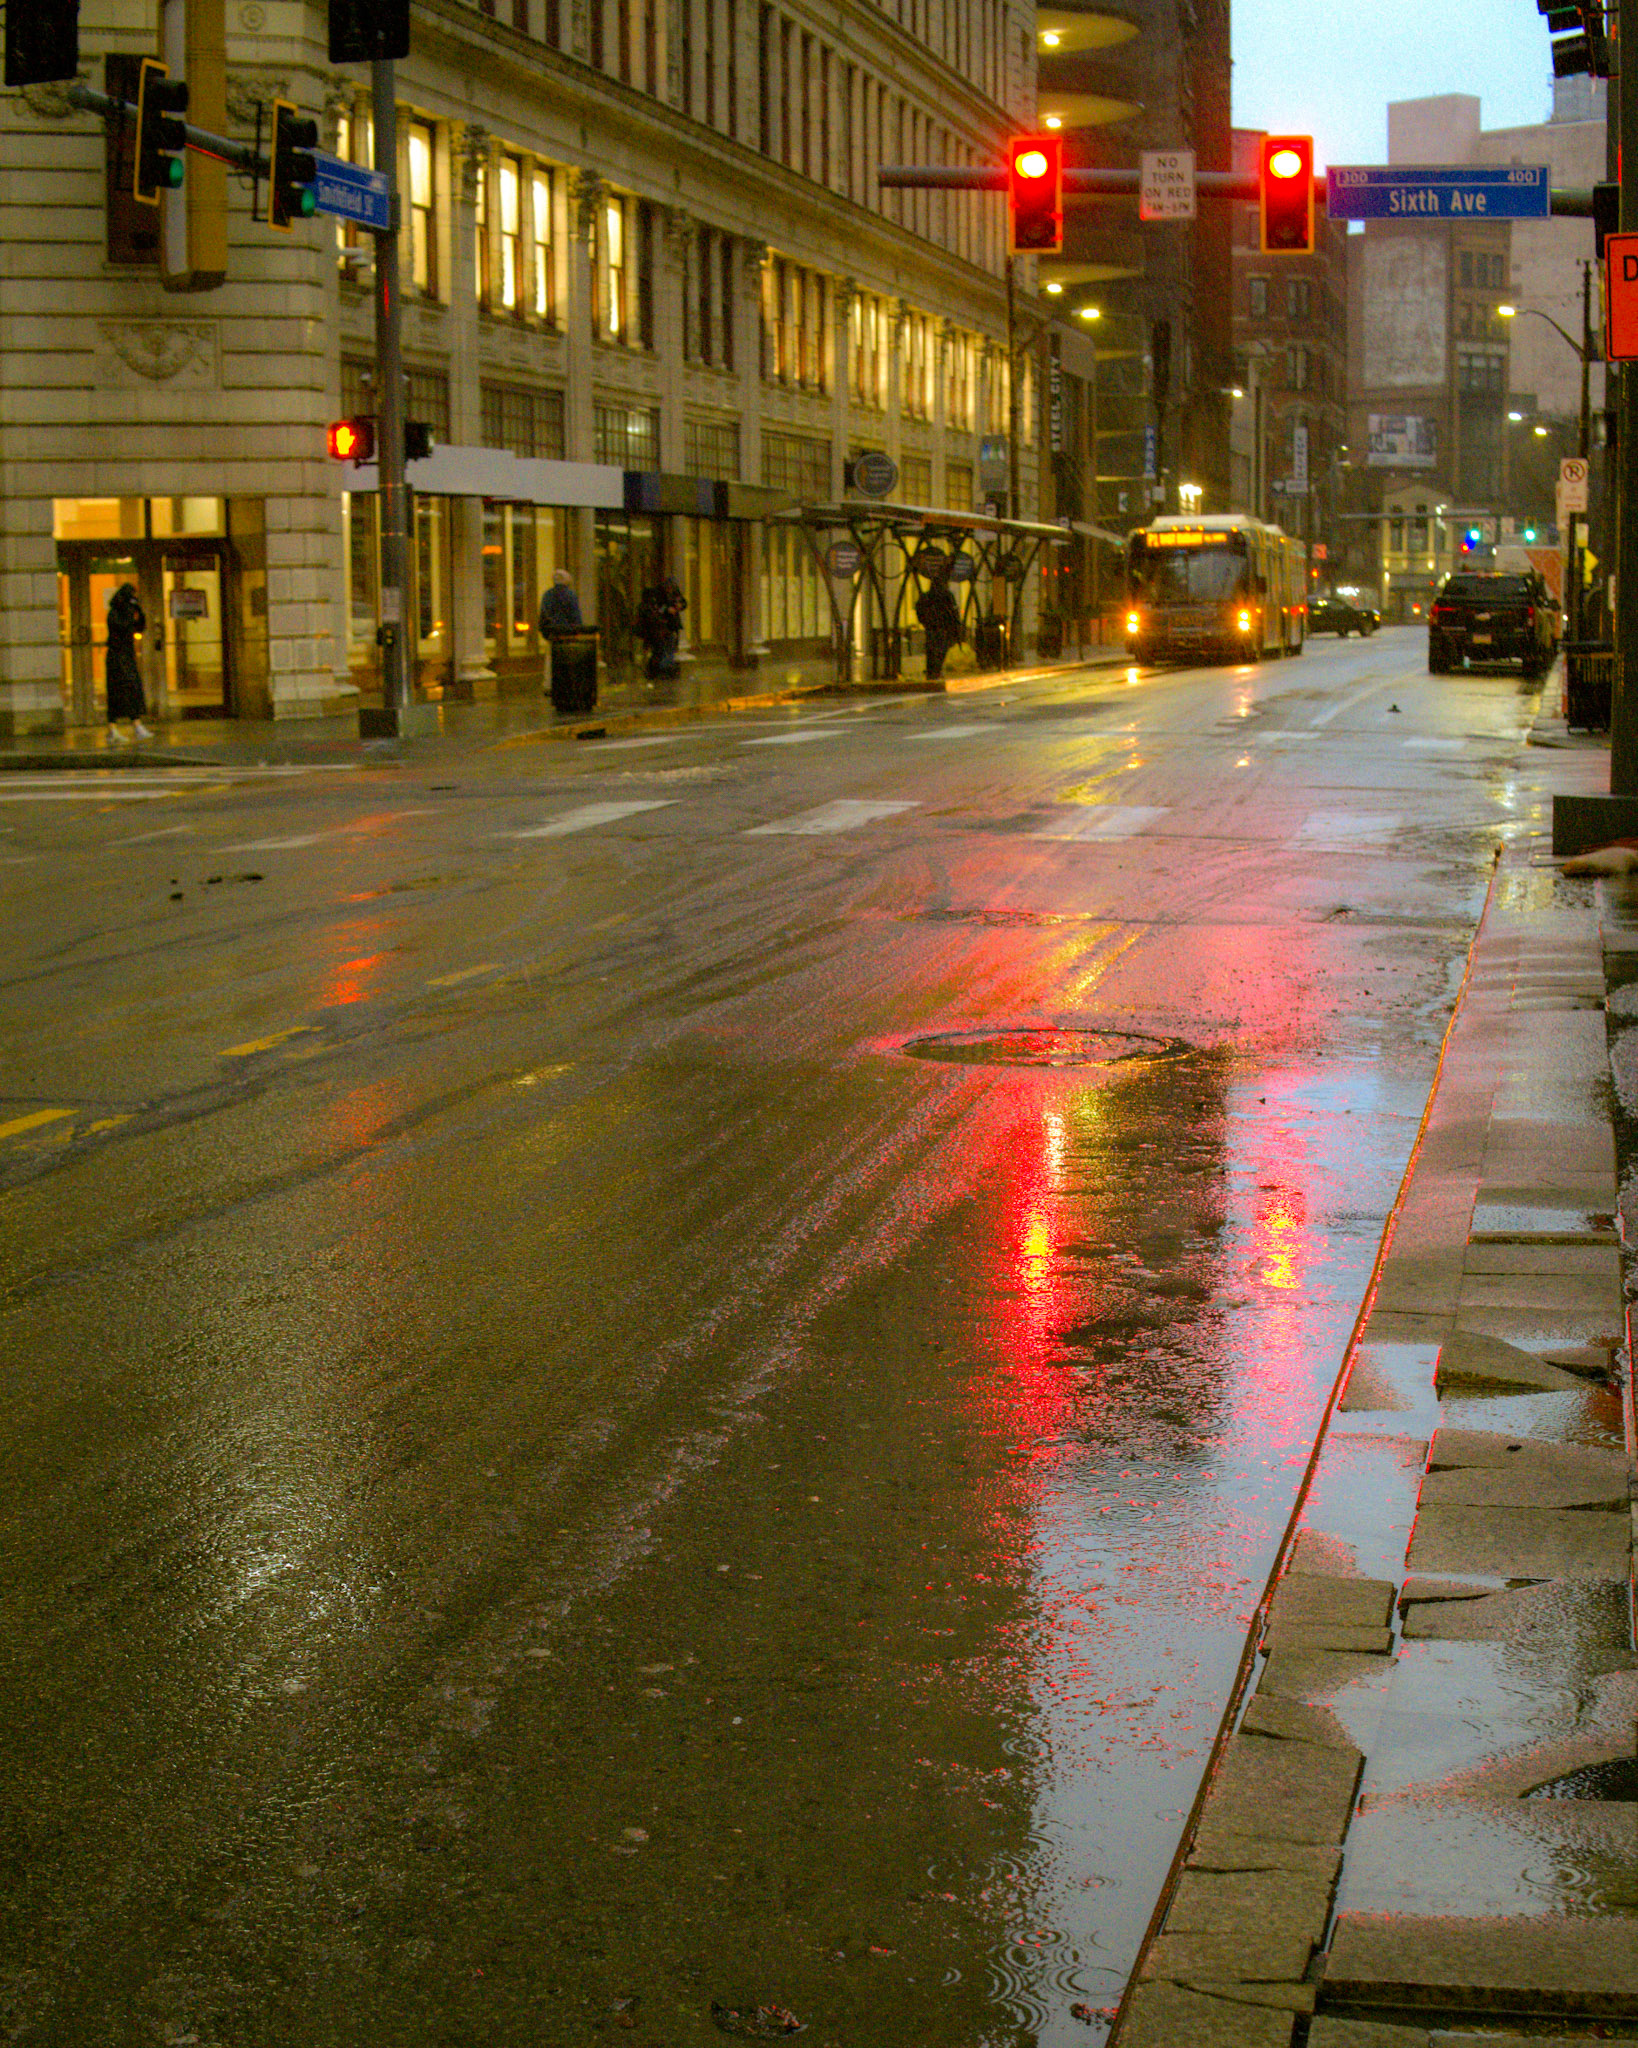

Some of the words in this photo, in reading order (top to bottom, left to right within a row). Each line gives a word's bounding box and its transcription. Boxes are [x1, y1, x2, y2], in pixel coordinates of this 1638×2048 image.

[1157, 157, 1178, 168] NO
[1152, 172, 1185, 183] TURN
[1344, 172, 1369, 184] 300
[1507, 171, 1533, 182] 400
[318, 181, 362, 213] Smithfield
[1144, 187, 1161, 198] ON
[1167, 187, 1191, 198] RED
[1389, 189, 1439, 213] Sixth
[1451, 190, 1487, 212] Ave
[1050, 355, 1061, 395] CITY
[1050, 403, 1061, 452] STEEL
